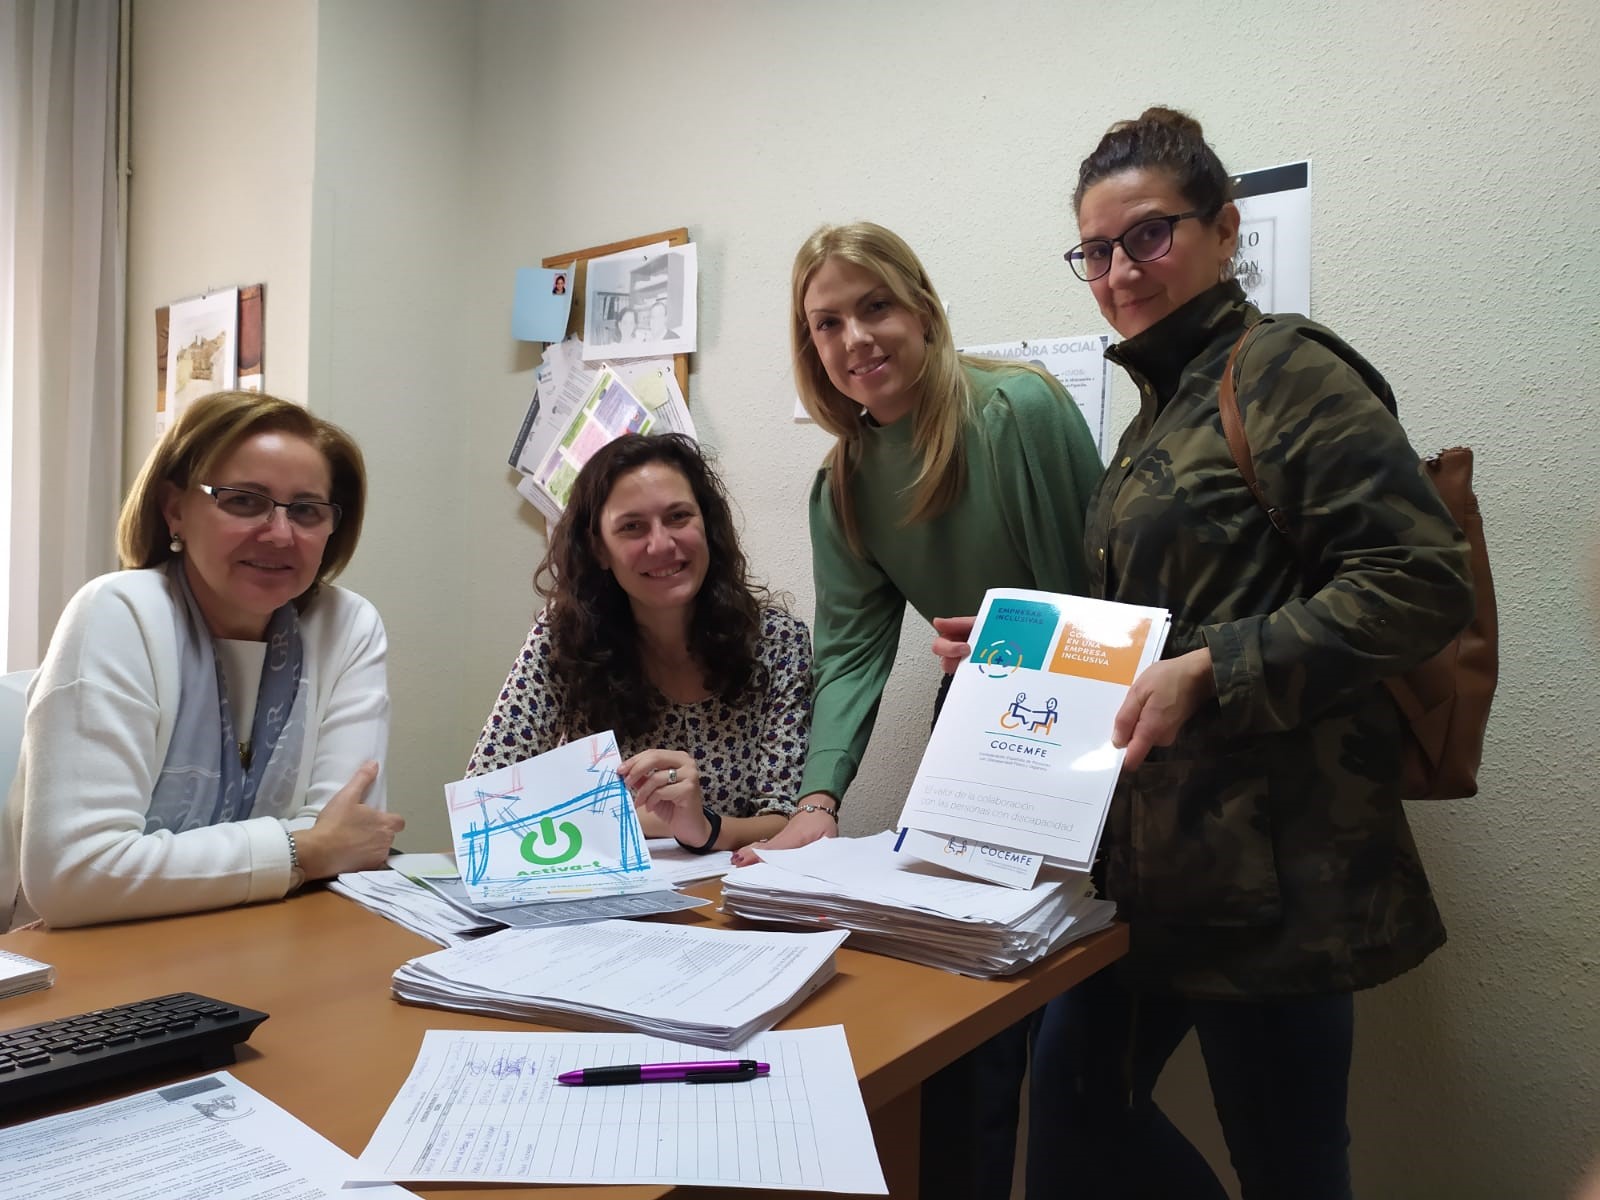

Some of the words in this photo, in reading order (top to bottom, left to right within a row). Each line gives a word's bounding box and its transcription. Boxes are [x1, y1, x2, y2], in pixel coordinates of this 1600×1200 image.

[1051, 341, 1097, 355] SOCIAL
[998, 607, 1043, 617] EMPRESAS
[995, 614, 1045, 625] INCLUSIVAS
[1067, 637, 1080, 646] EN
[1081, 640, 1101, 649] UNA
[1063, 645, 1107, 658] EMPRESA
[1061, 652, 1110, 666] INCLUSIVA
[990, 740, 1048, 758] COCEMFE
[950, 802, 990, 816] personas
[1010, 813, 1075, 832] discapacidad
[980, 845, 1033, 866] COCEMFE
[516, 860, 602, 877] Activa-t
